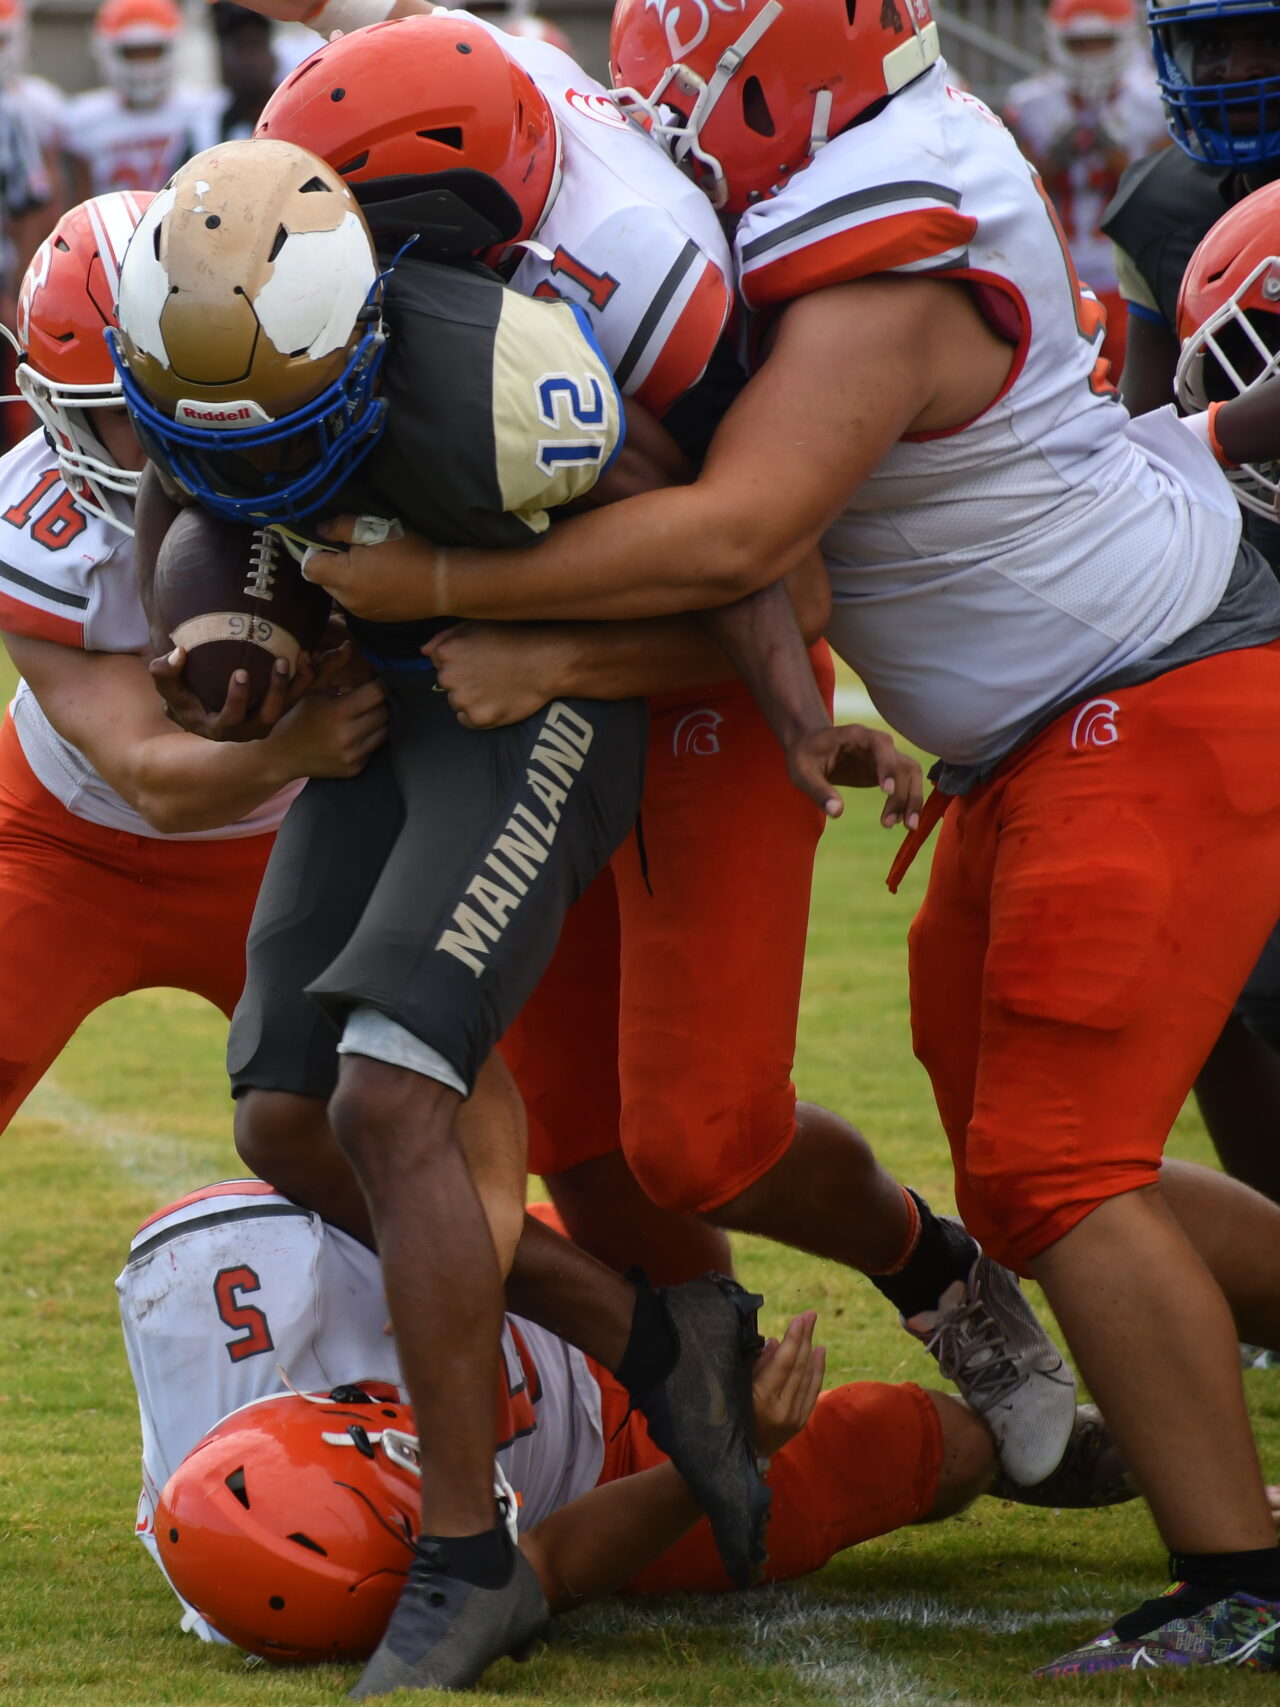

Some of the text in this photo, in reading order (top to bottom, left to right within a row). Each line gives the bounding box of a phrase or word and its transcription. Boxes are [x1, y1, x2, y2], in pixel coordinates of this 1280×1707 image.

[532, 243, 621, 313] 1
[182, 406, 252, 422] Riddell
[533, 371, 608, 477] 12
[0, 468, 103, 552] 16
[435, 701, 594, 979] MAINLAND
[213, 1263, 275, 1364] 5
